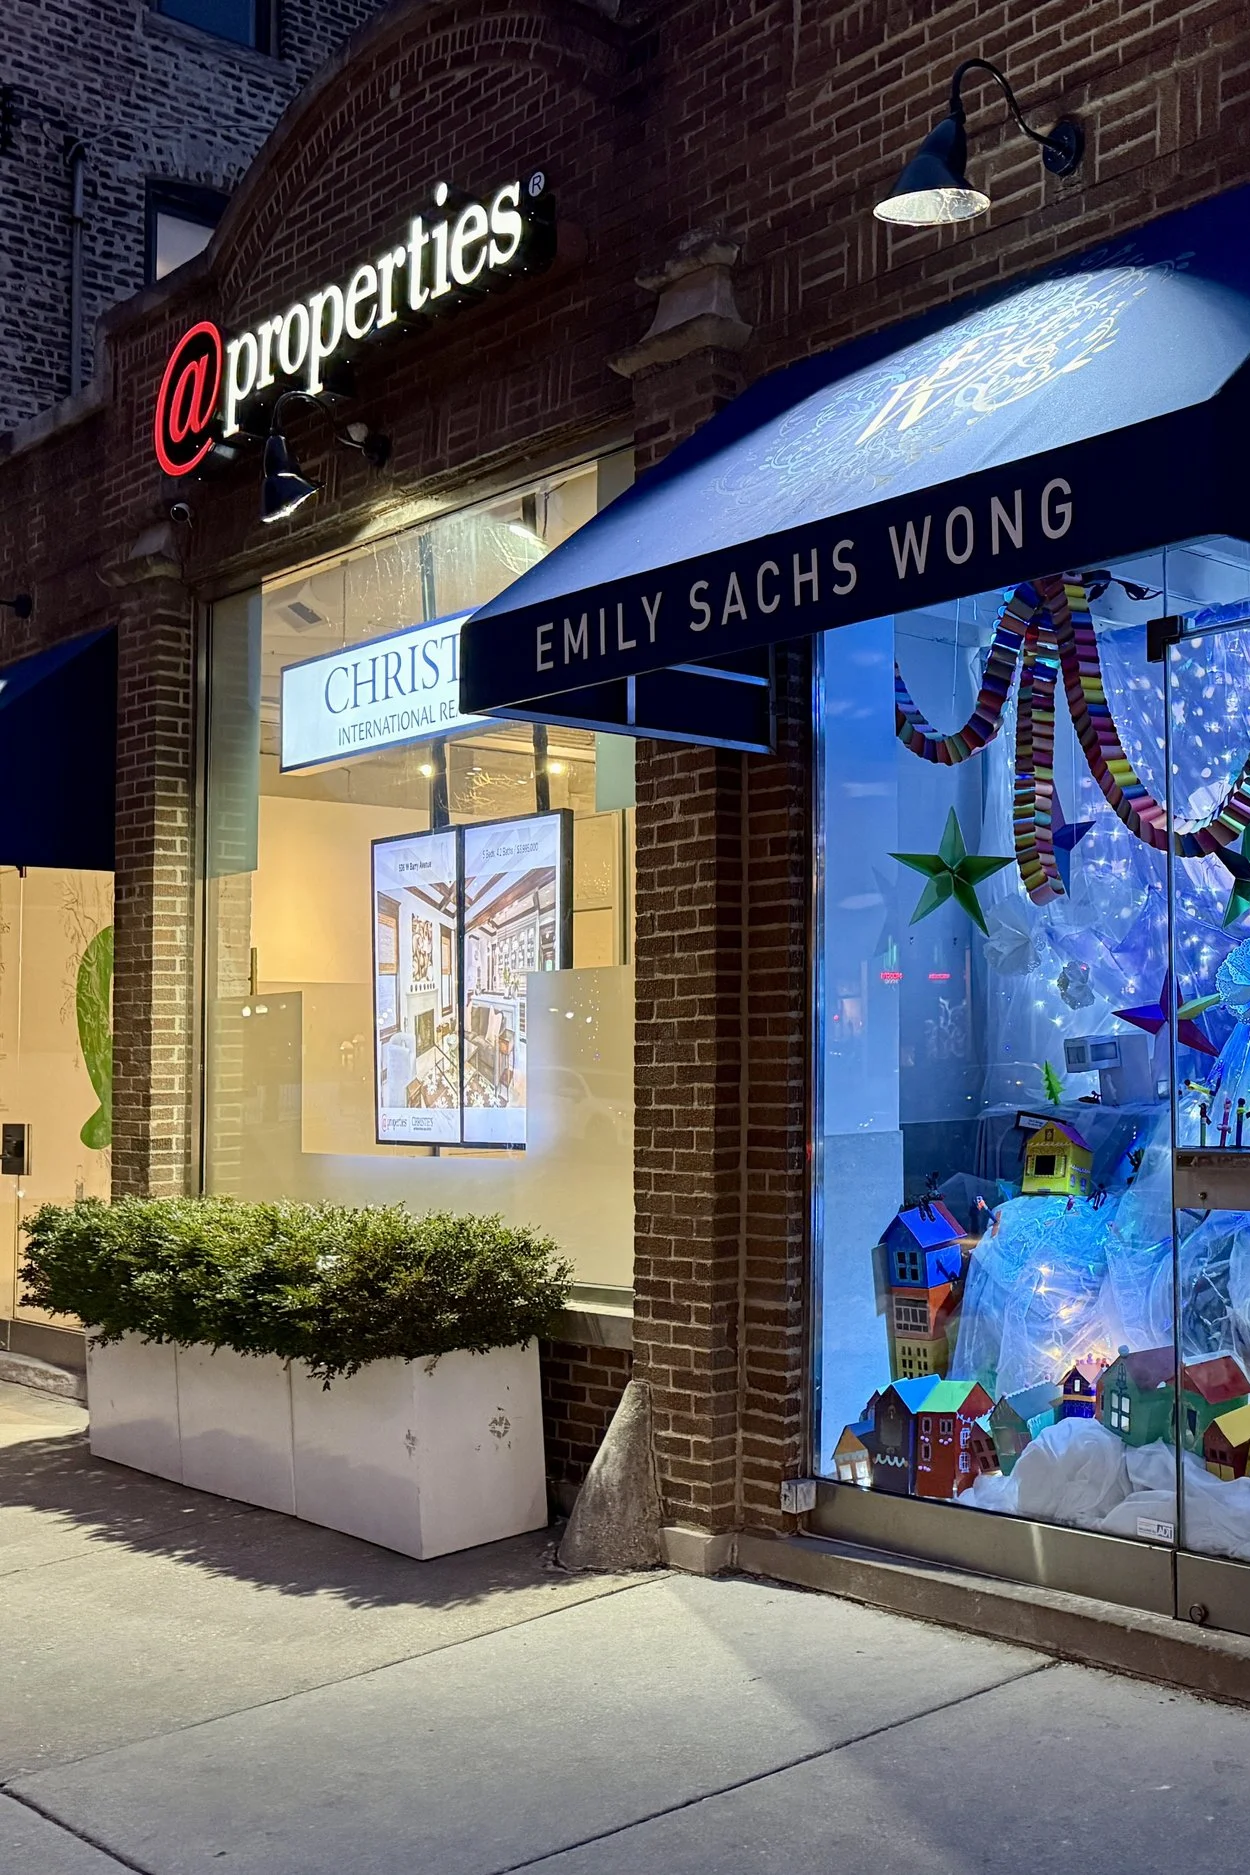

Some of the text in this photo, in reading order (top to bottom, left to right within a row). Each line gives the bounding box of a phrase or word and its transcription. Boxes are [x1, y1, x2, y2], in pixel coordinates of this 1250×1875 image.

[536, 477, 1073, 672] EMILY SACHS WONG
[338, 699, 460, 746] INTERNATIONAL RE
[1157, 1525, 1173, 1540] ADT
